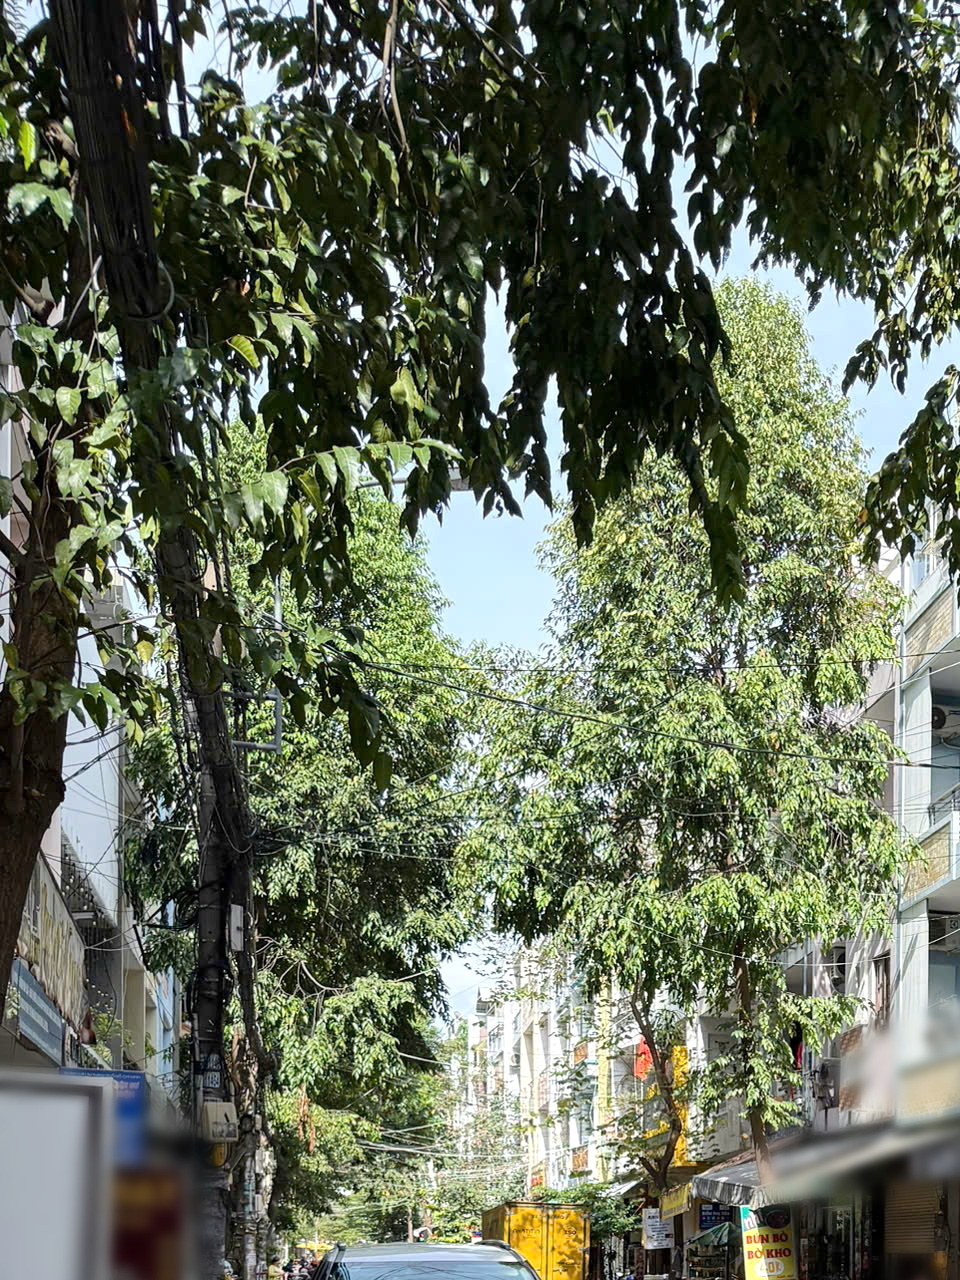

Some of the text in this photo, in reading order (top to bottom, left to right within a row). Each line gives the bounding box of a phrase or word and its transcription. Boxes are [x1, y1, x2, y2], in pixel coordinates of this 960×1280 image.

[772, 1231, 788, 1243] BÒ
[747, 1248, 792, 1259] BÒ KHO
